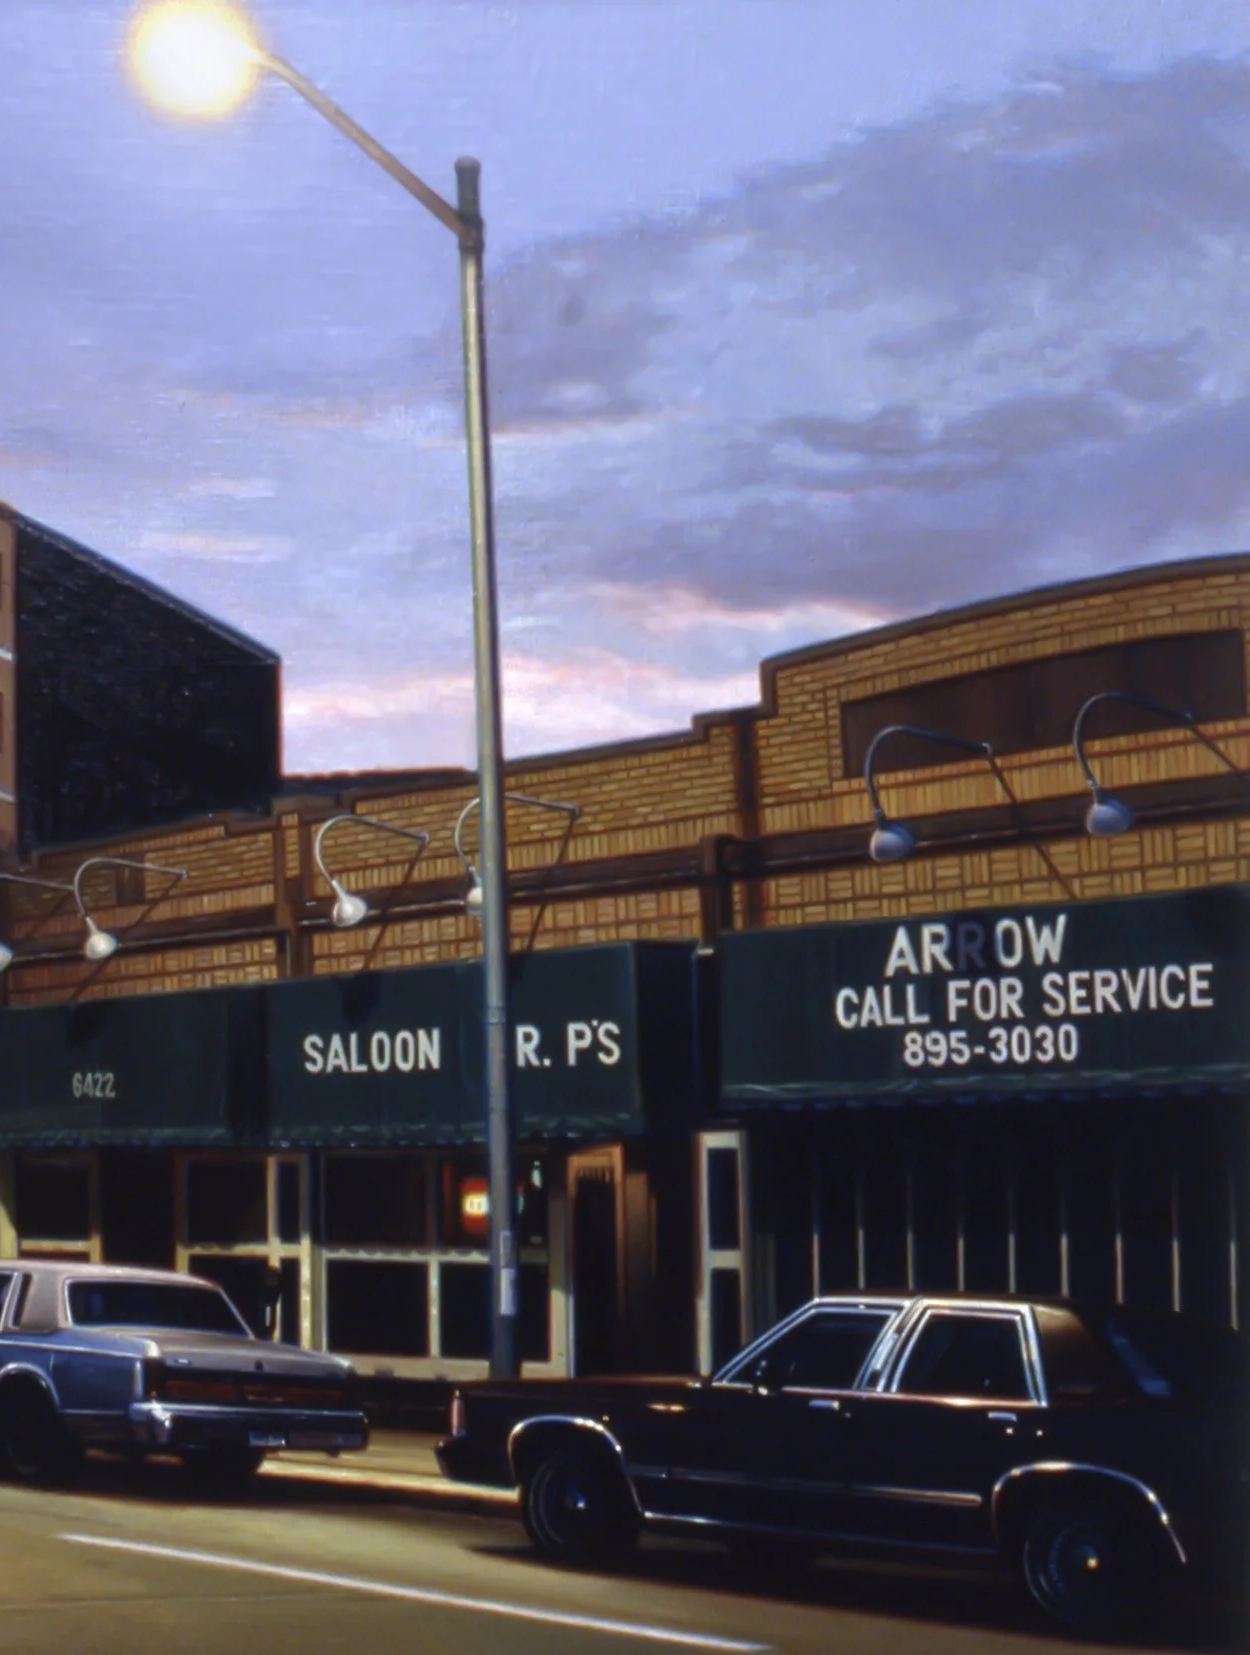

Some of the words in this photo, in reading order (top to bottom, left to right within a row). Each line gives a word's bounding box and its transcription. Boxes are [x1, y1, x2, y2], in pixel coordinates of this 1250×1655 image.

[885, 914, 1067, 978] ARROW
[835, 984, 930, 1029] CALL
[948, 977, 1025, 1022] FOR
[1042, 963, 1214, 1017] SERVICE
[303, 1028, 441, 1073] SALOON
[903, 1023, 1079, 1067] 895-3030
[72, 1071, 116, 1098] 6422
